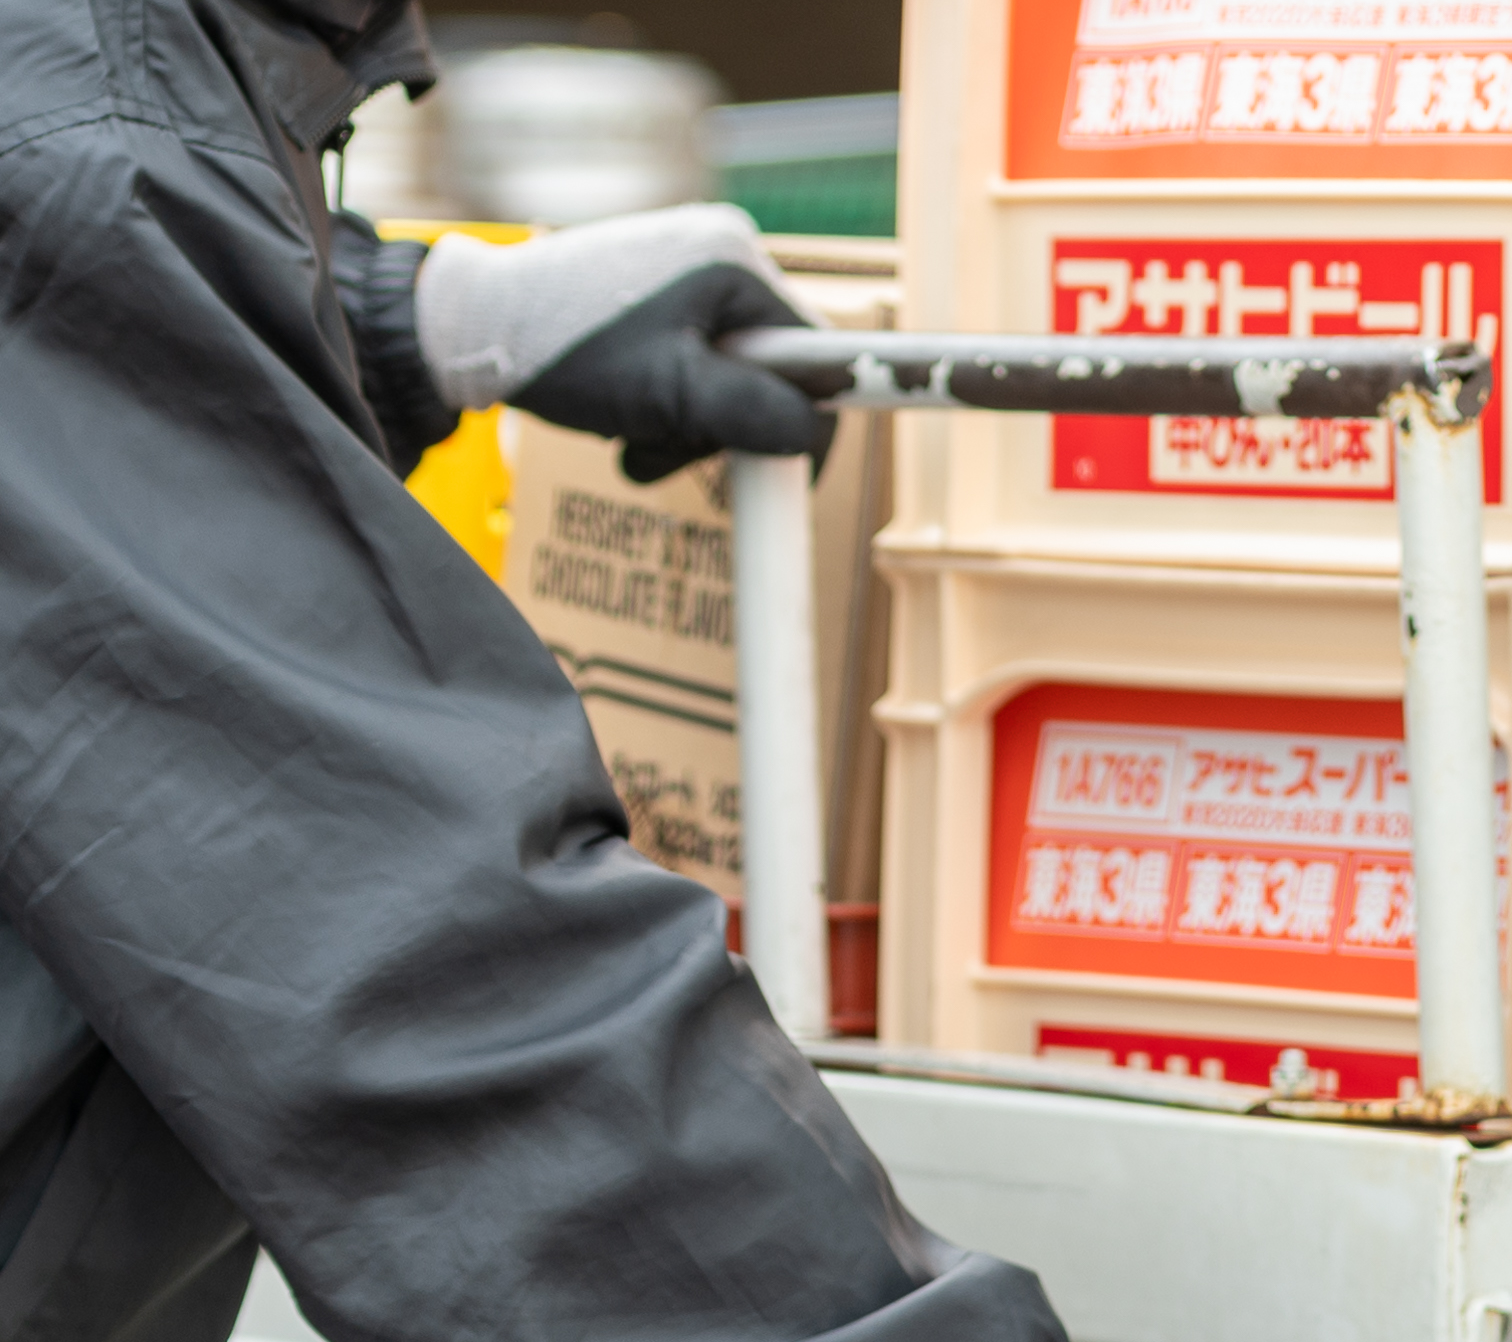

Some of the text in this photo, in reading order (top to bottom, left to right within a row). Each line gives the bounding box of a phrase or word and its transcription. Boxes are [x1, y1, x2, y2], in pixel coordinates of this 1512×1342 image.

[1054, 746, 1167, 809] 1A766
[1178, 853, 1337, 943] 東海3県
